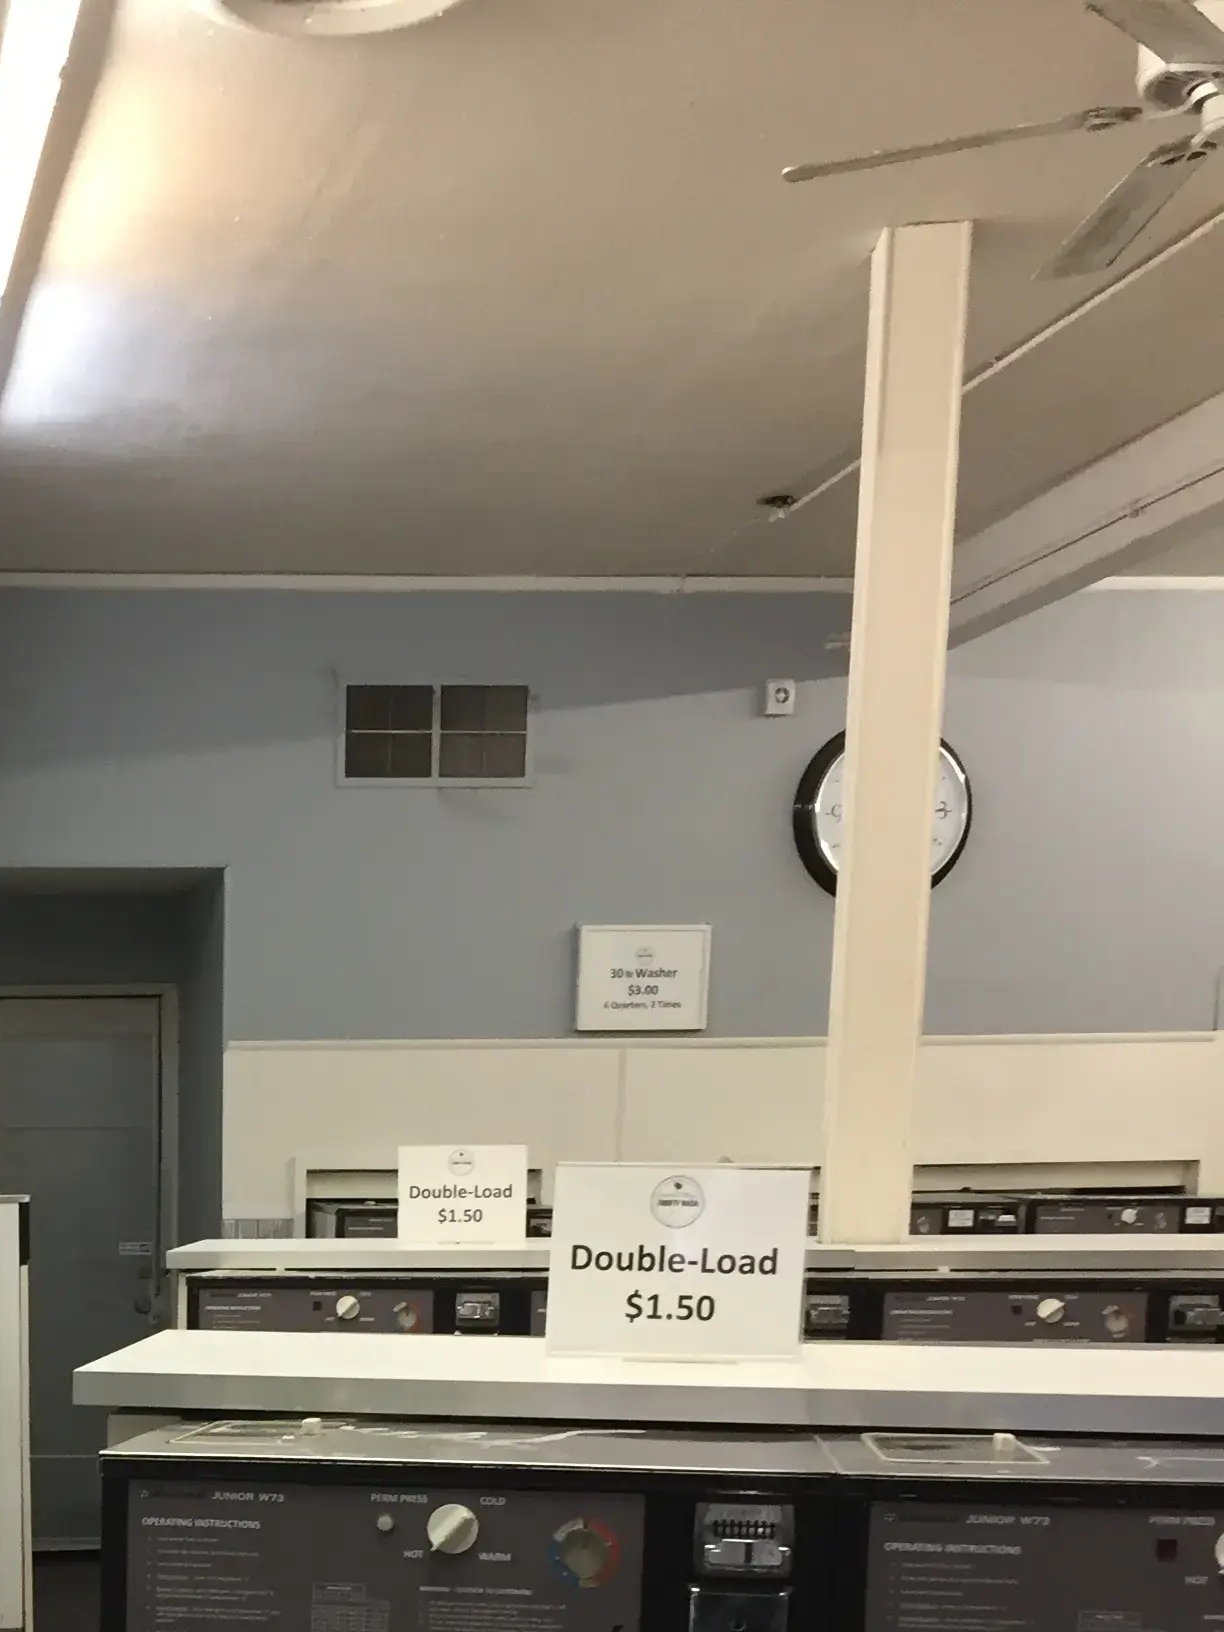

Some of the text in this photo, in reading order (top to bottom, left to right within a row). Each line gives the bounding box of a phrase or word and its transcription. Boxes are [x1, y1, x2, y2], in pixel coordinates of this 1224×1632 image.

[627, 984, 659, 997] $3.00
[409, 1184, 513, 1199] Double-Load
[437, 1208, 483, 1224] $1.50
[570, 1244, 779, 1275] Double-Load
[624, 1289, 716, 1323] $1.50
[211, 1491, 255, 1501] JUNIOR
